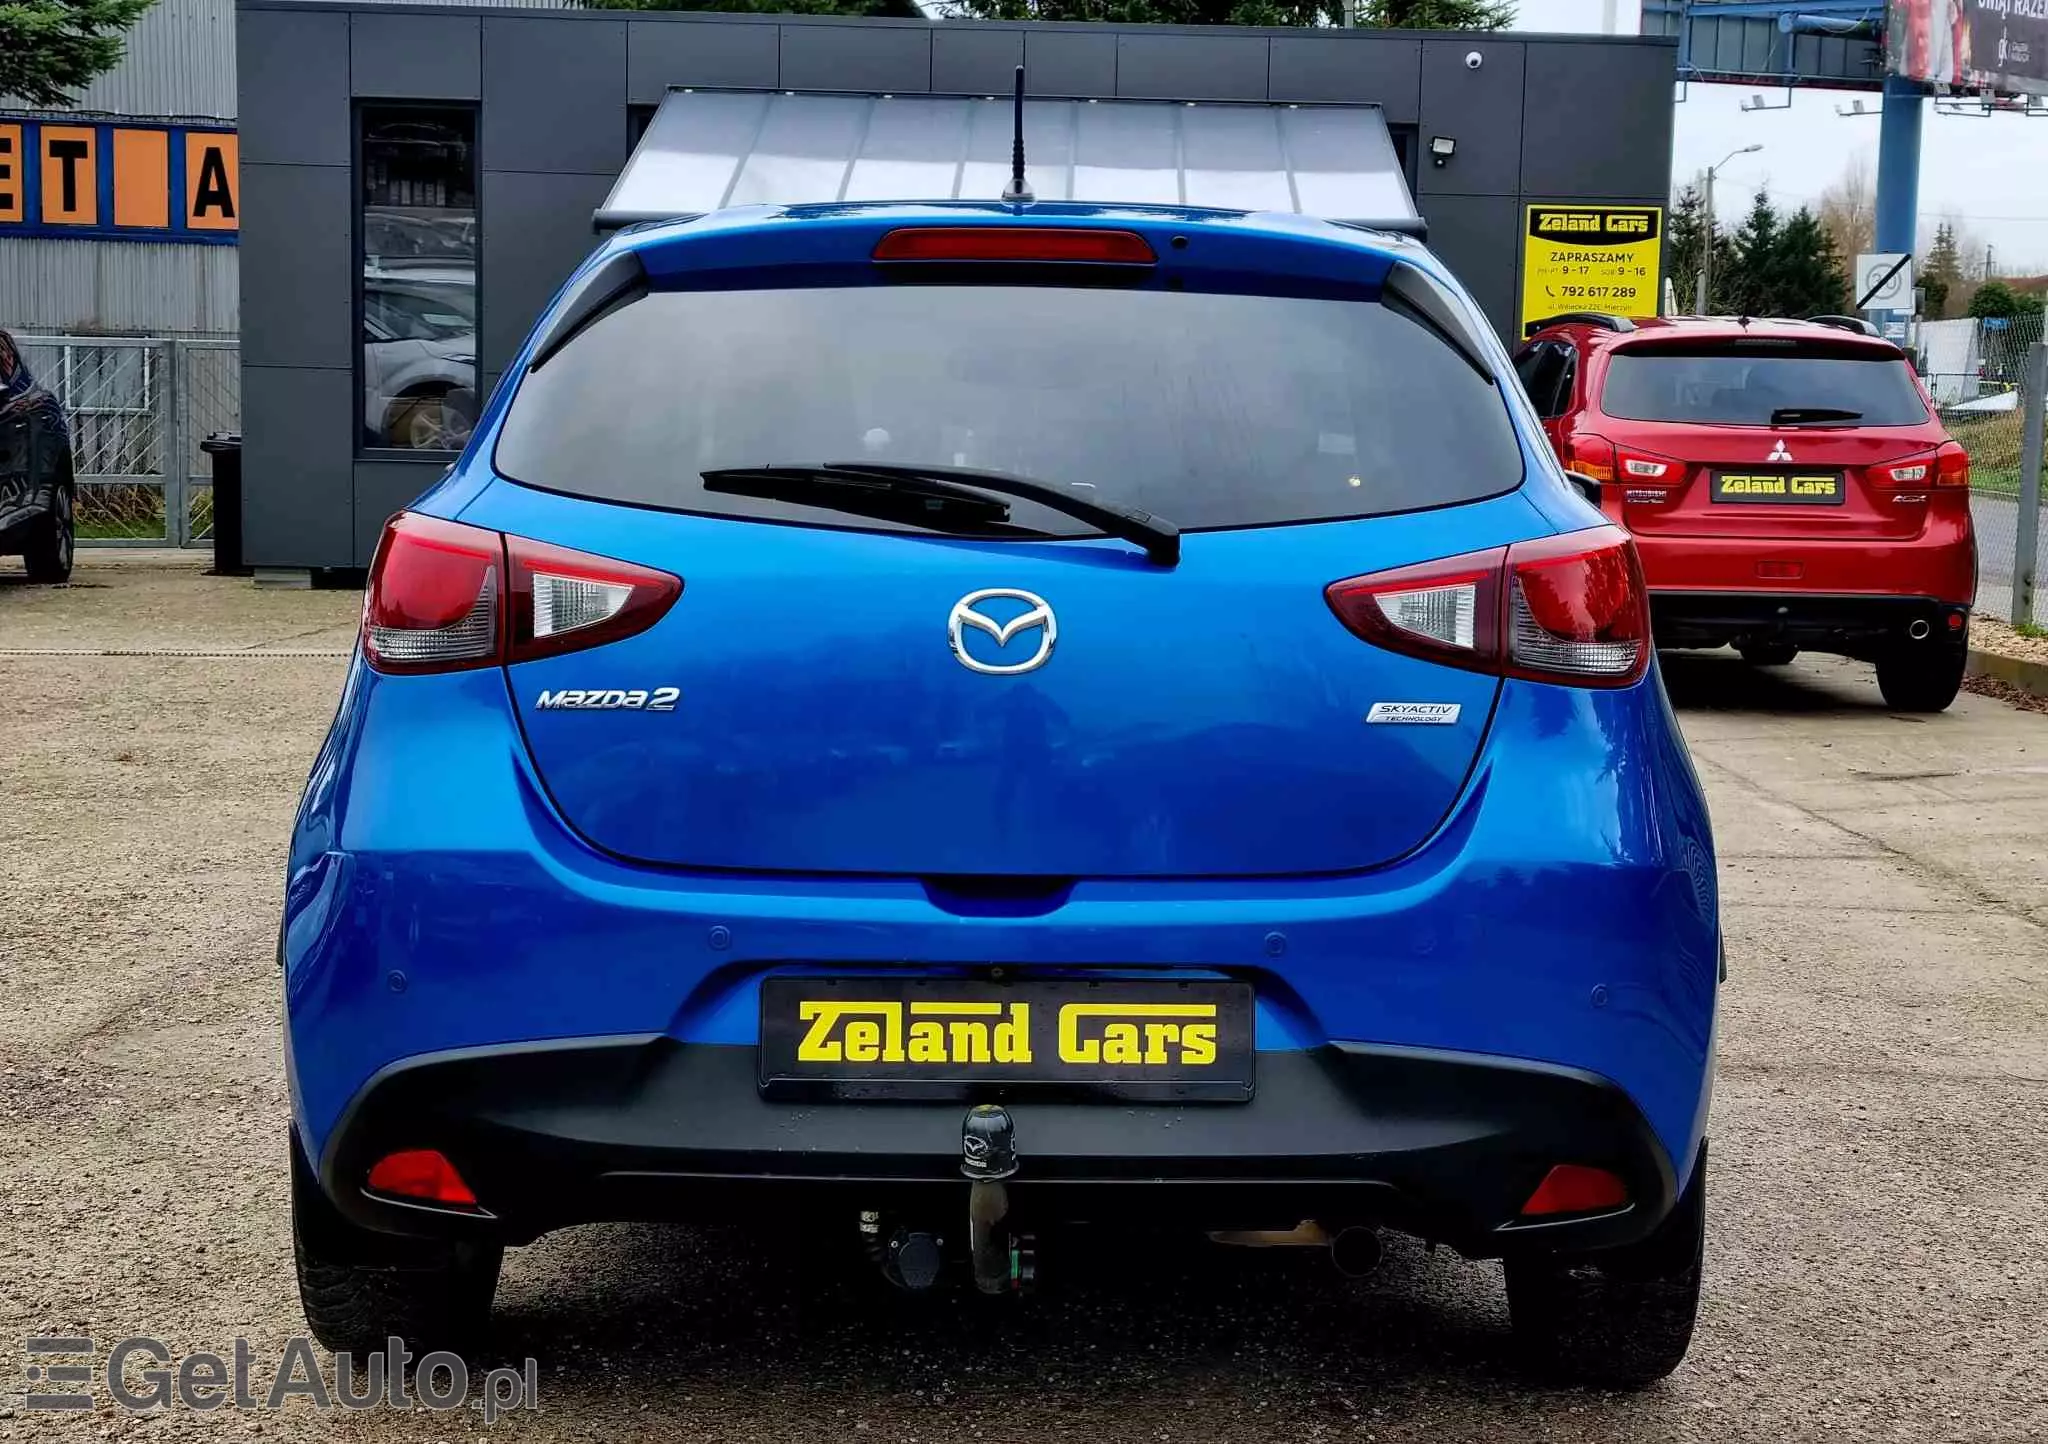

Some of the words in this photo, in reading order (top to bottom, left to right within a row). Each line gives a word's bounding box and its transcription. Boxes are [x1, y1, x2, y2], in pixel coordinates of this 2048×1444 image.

[2014, 0, 2048, 19] RAZE
[193, 147, 235, 218] A
[1539, 213, 1601, 232] Zeland
[1606, 214, 1649, 232] Cars
[1550, 252, 1634, 263] ZAPRASZAMY
[1562, 266, 1569, 274] 9
[1579, 265, 1590, 275] 17
[1617, 267, 1625, 276] 9
[1635, 267, 1646, 276] 16
[1561, 286, 1585, 297] 792
[1588, 287, 1609, 297] 617
[1612, 287, 1636, 297] 289
[1721, 475, 1786, 494] Zeland
[1791, 476, 1836, 495] Cars
[1379, 704, 1453, 714] SKYACTIV
[797, 1000, 1033, 1063] Zeland
[1057, 1002, 1217, 1065] Cars
